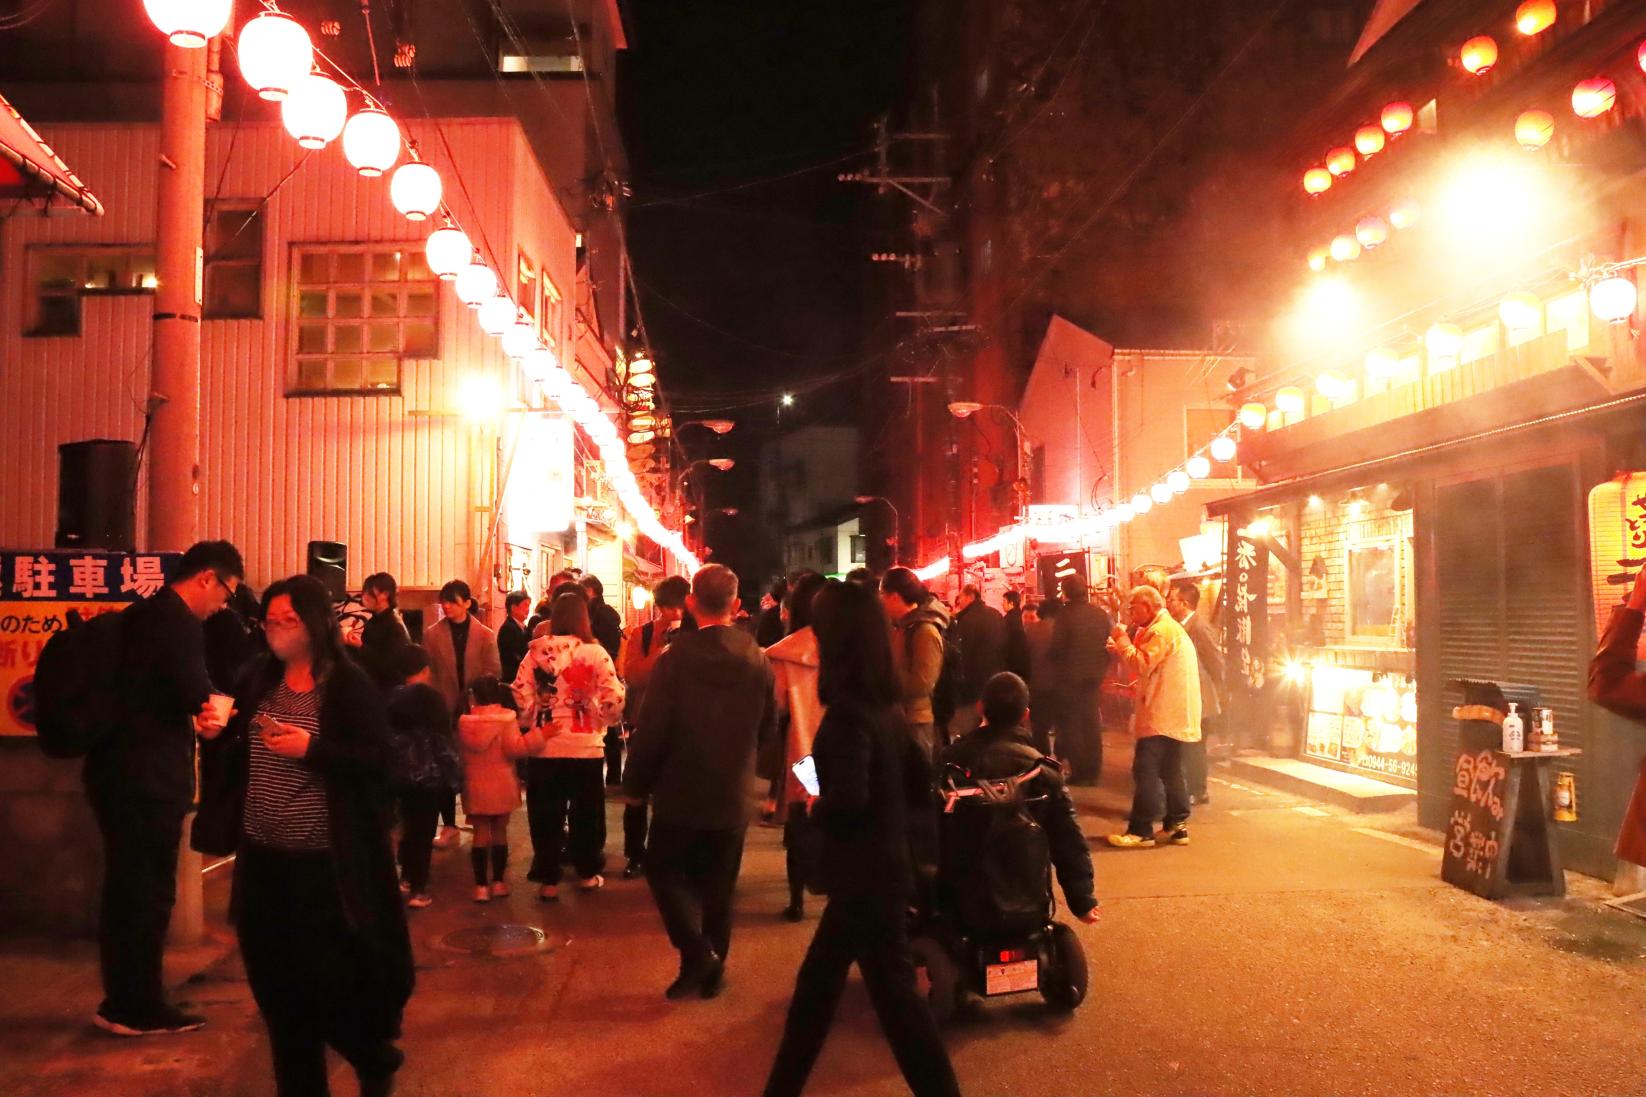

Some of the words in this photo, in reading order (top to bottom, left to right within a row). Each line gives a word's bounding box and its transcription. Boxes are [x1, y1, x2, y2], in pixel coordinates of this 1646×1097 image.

[0, 555, 165, 599] 駐車場
[0, 614, 63, 634] のため
